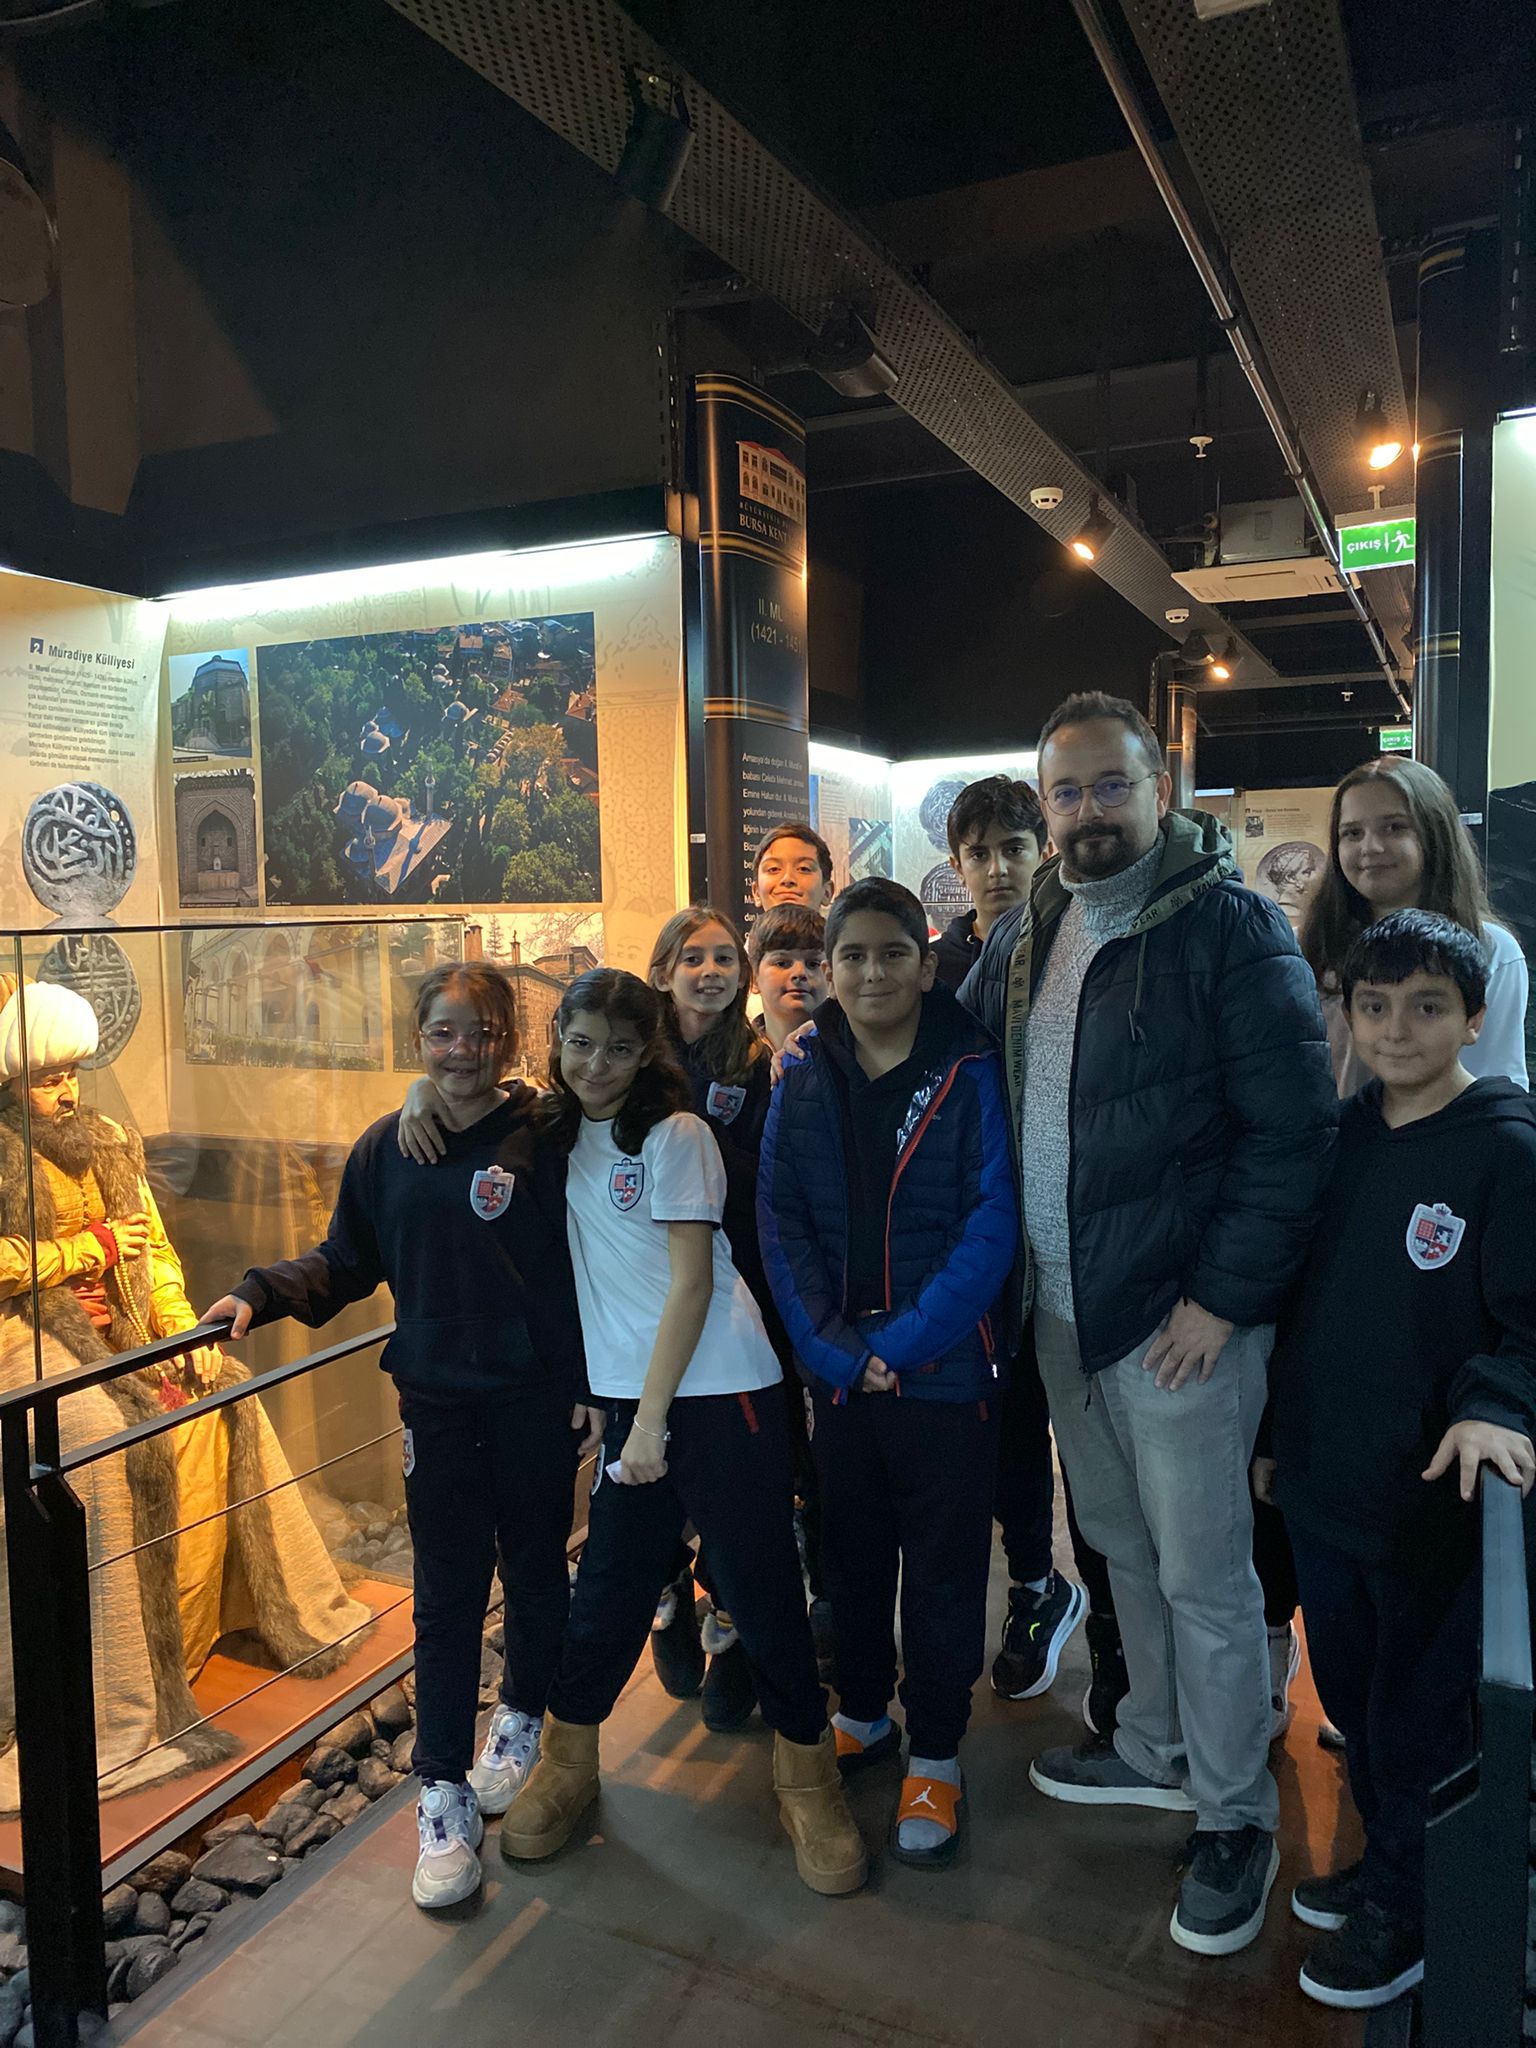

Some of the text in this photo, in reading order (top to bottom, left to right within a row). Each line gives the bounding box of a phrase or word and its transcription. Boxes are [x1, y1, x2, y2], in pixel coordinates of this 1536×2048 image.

[739, 513, 768, 535] BURSA
[768, 524, 788, 545] KENT
[1347, 538, 1382, 554] ÇIKIŞ
[758, 598, 768, 617] II.
[751, 622, 778, 645] (1421
[49, 645, 92, 663] Muradiye
[95, 653, 134, 669] Külliyesi
[1011, 1025, 1023, 1058] DENIM
